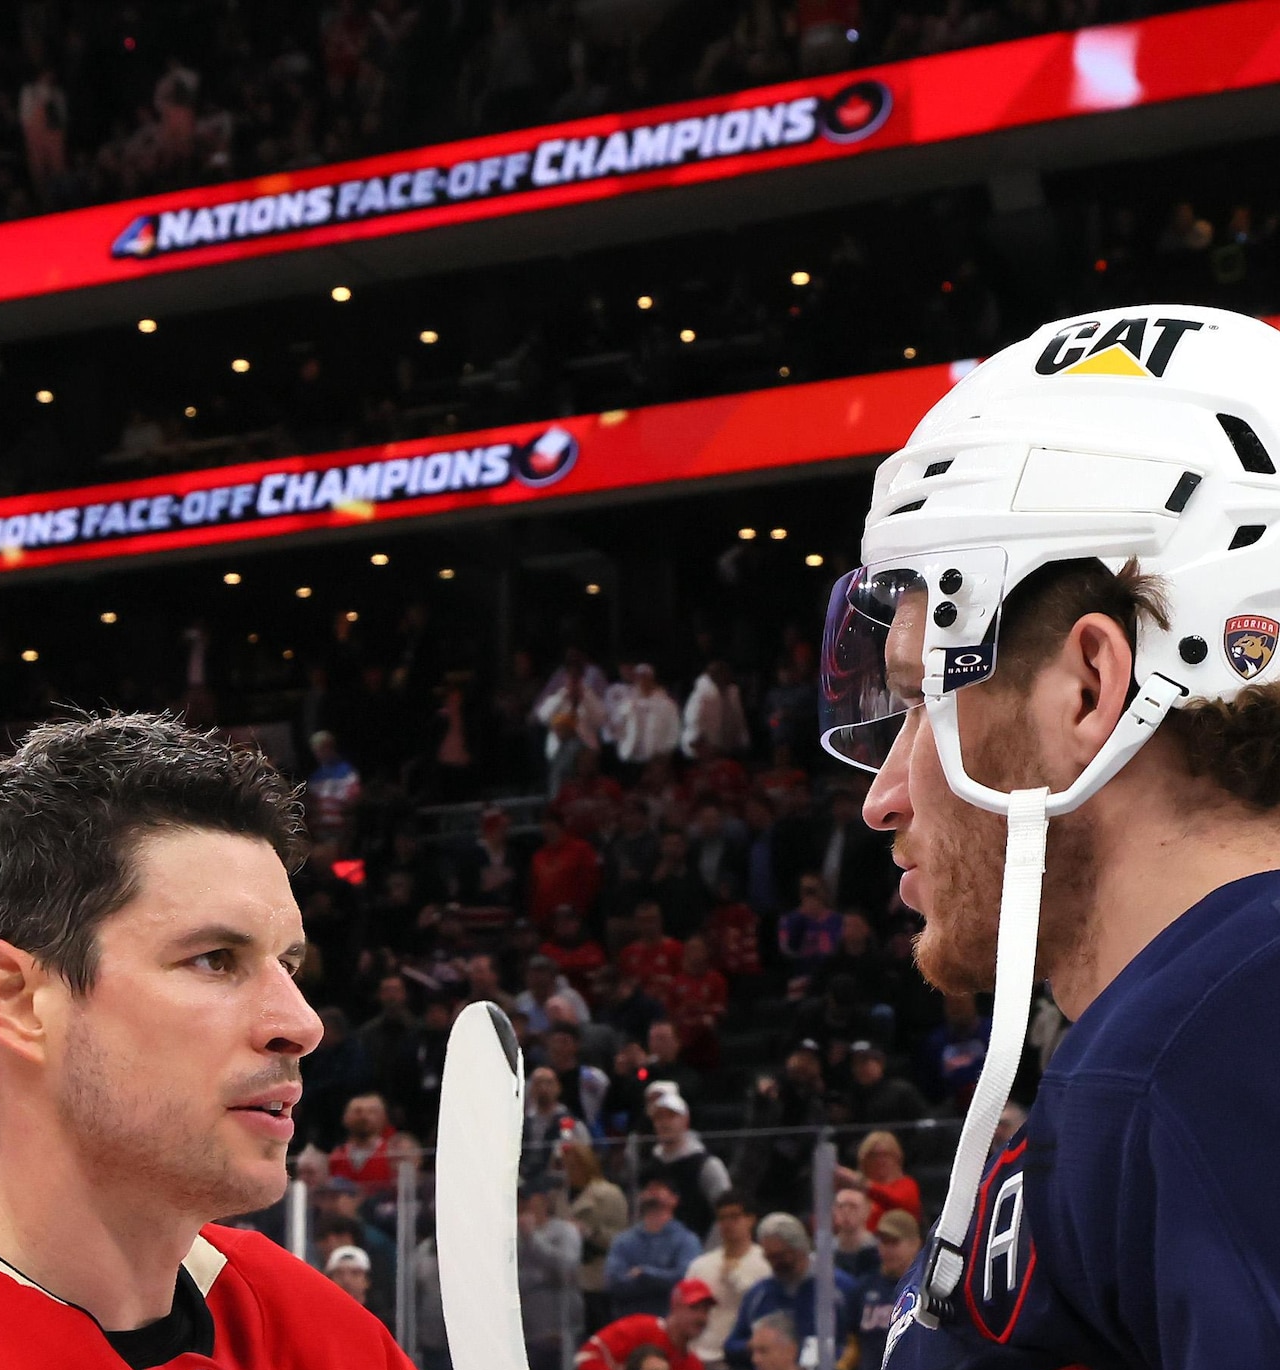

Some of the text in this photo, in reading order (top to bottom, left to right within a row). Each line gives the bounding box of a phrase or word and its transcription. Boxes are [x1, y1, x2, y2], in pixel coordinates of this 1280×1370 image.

[157, 185, 336, 250] NATIONS
[336, 151, 531, 217] FACE-OFF
[531, 97, 820, 187] CHAMPIONS
[1035, 318, 1204, 378] CAT
[80, 483, 257, 538] FACE-OFF
[257, 444, 512, 515] CHAMPIONS
[1230, 619, 1274, 633] FLORIDA
[983, 1171, 1024, 1302] A
